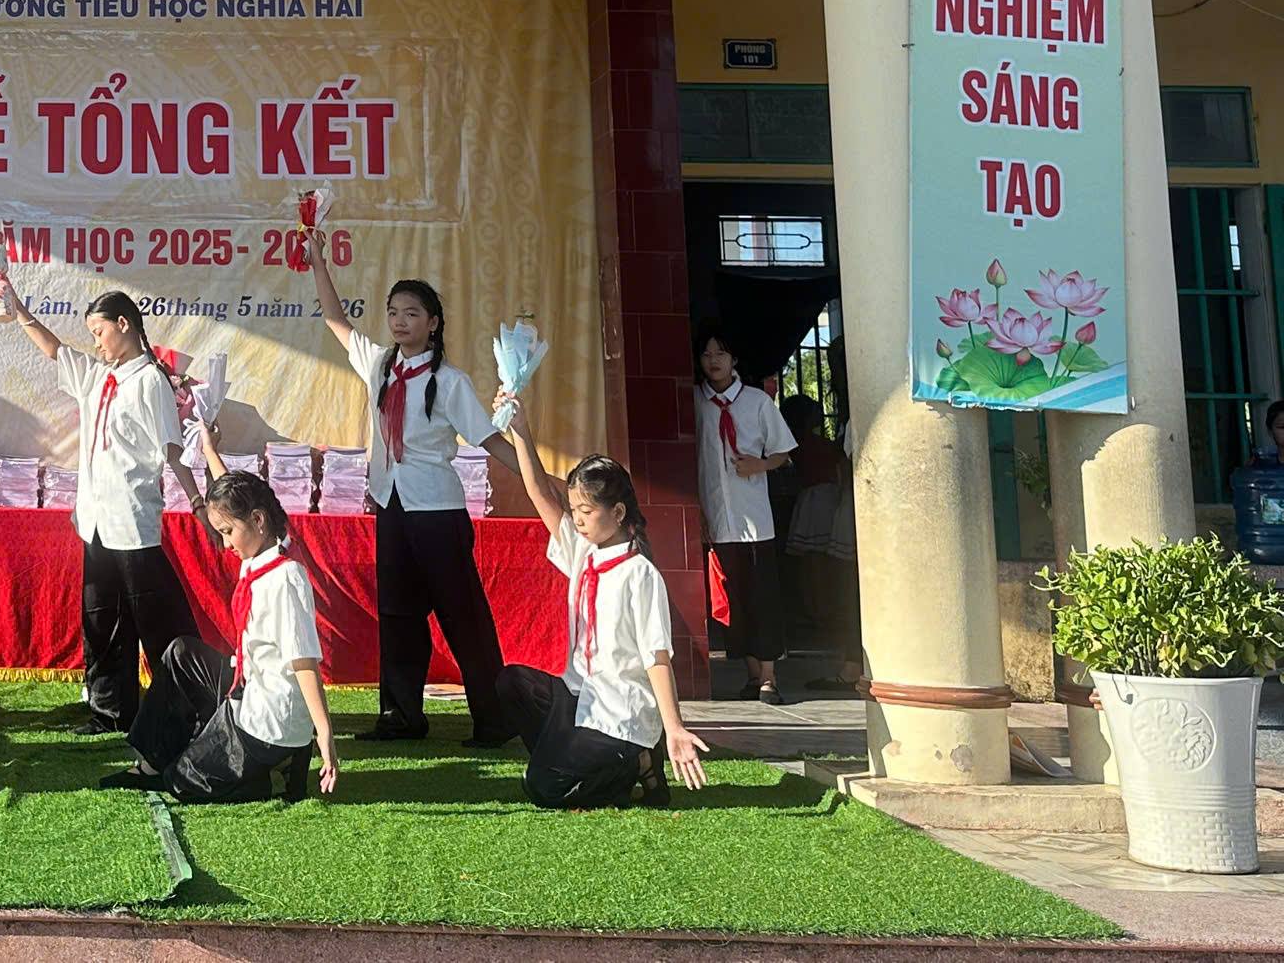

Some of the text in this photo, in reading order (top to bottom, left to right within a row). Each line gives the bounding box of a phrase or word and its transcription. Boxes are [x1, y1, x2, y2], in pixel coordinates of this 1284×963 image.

[37, 71, 230, 175] TỔNG
[260, 78, 395, 175] KẾT
[961, 61, 1080, 130] SÁNG
[979, 159, 1061, 227] TẠO
[66, 227, 135, 273] HỌC
[236, 296, 253, 317] 5
[256, 298, 303, 318] năm
[310, 298, 365, 318] 226
